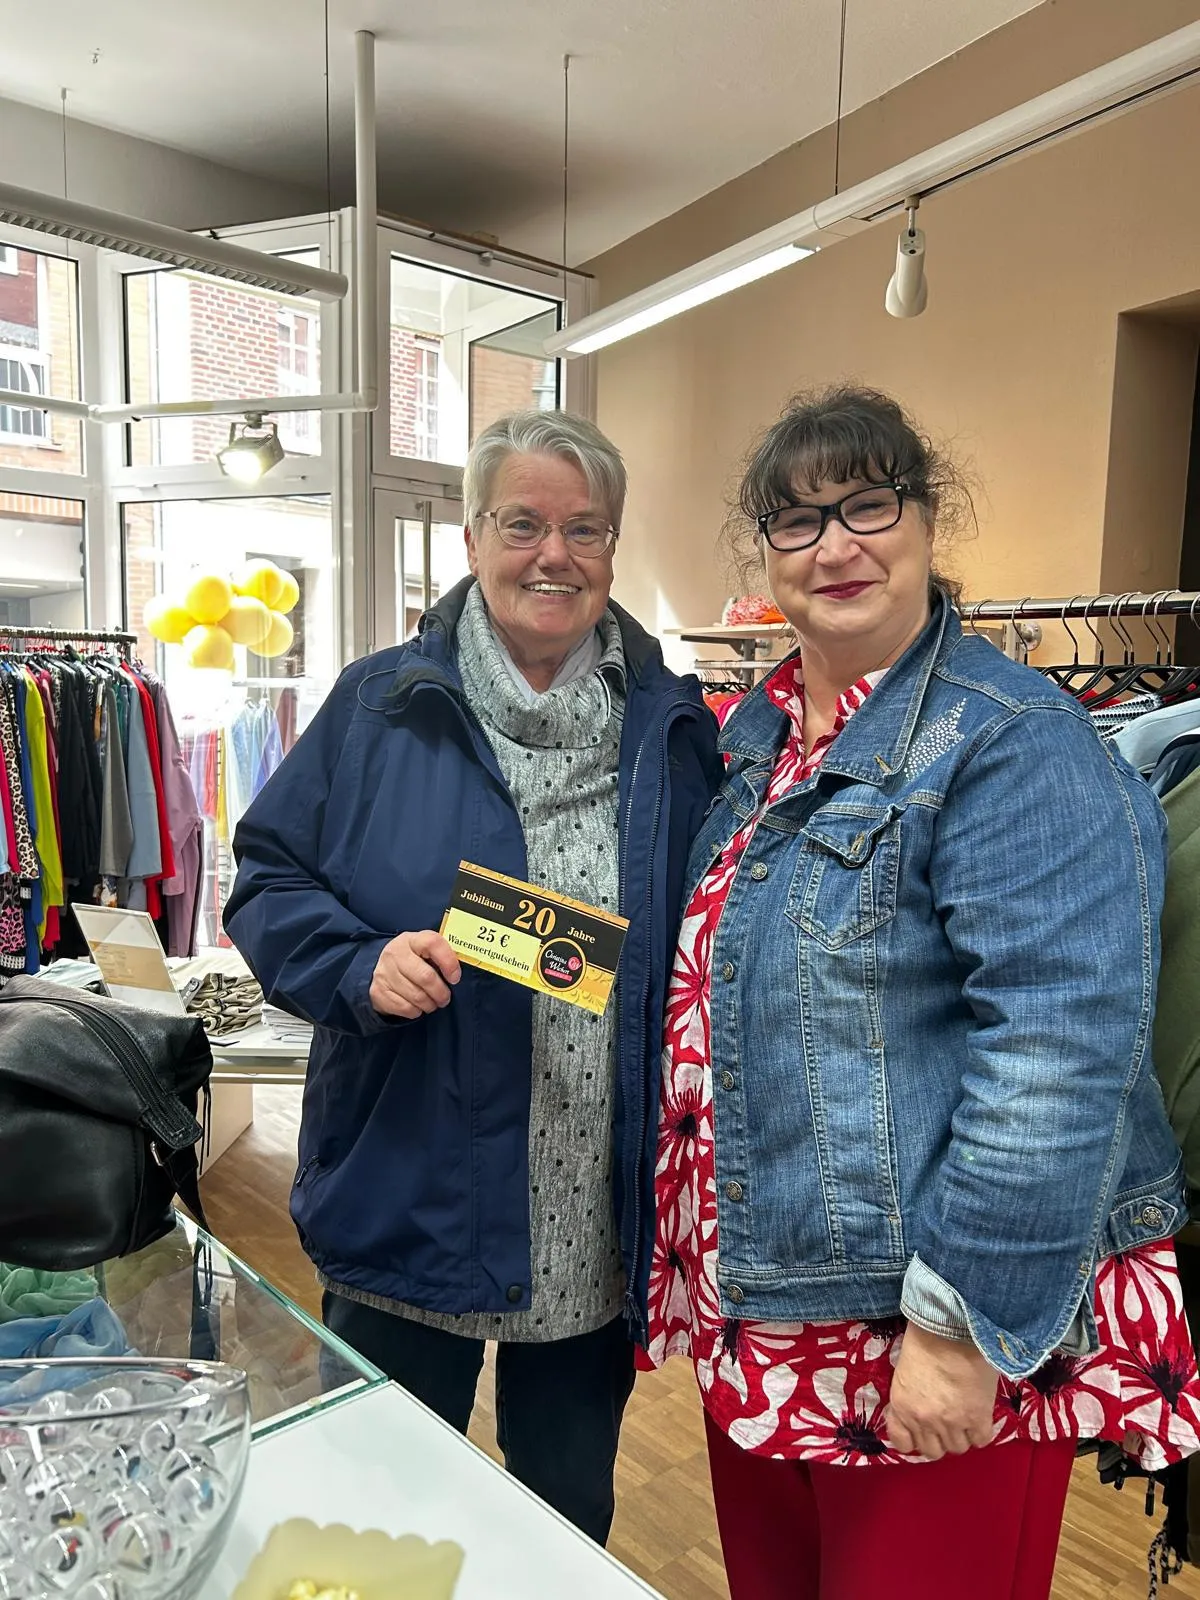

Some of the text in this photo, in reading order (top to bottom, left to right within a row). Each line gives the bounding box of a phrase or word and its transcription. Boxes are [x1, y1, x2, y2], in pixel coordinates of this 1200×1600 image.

[461, 890, 595, 943] Jubiläum 20 Jahre
[448, 934, 530, 972] Warenwertgutschein
[477, 926, 510, 947] 25 €
